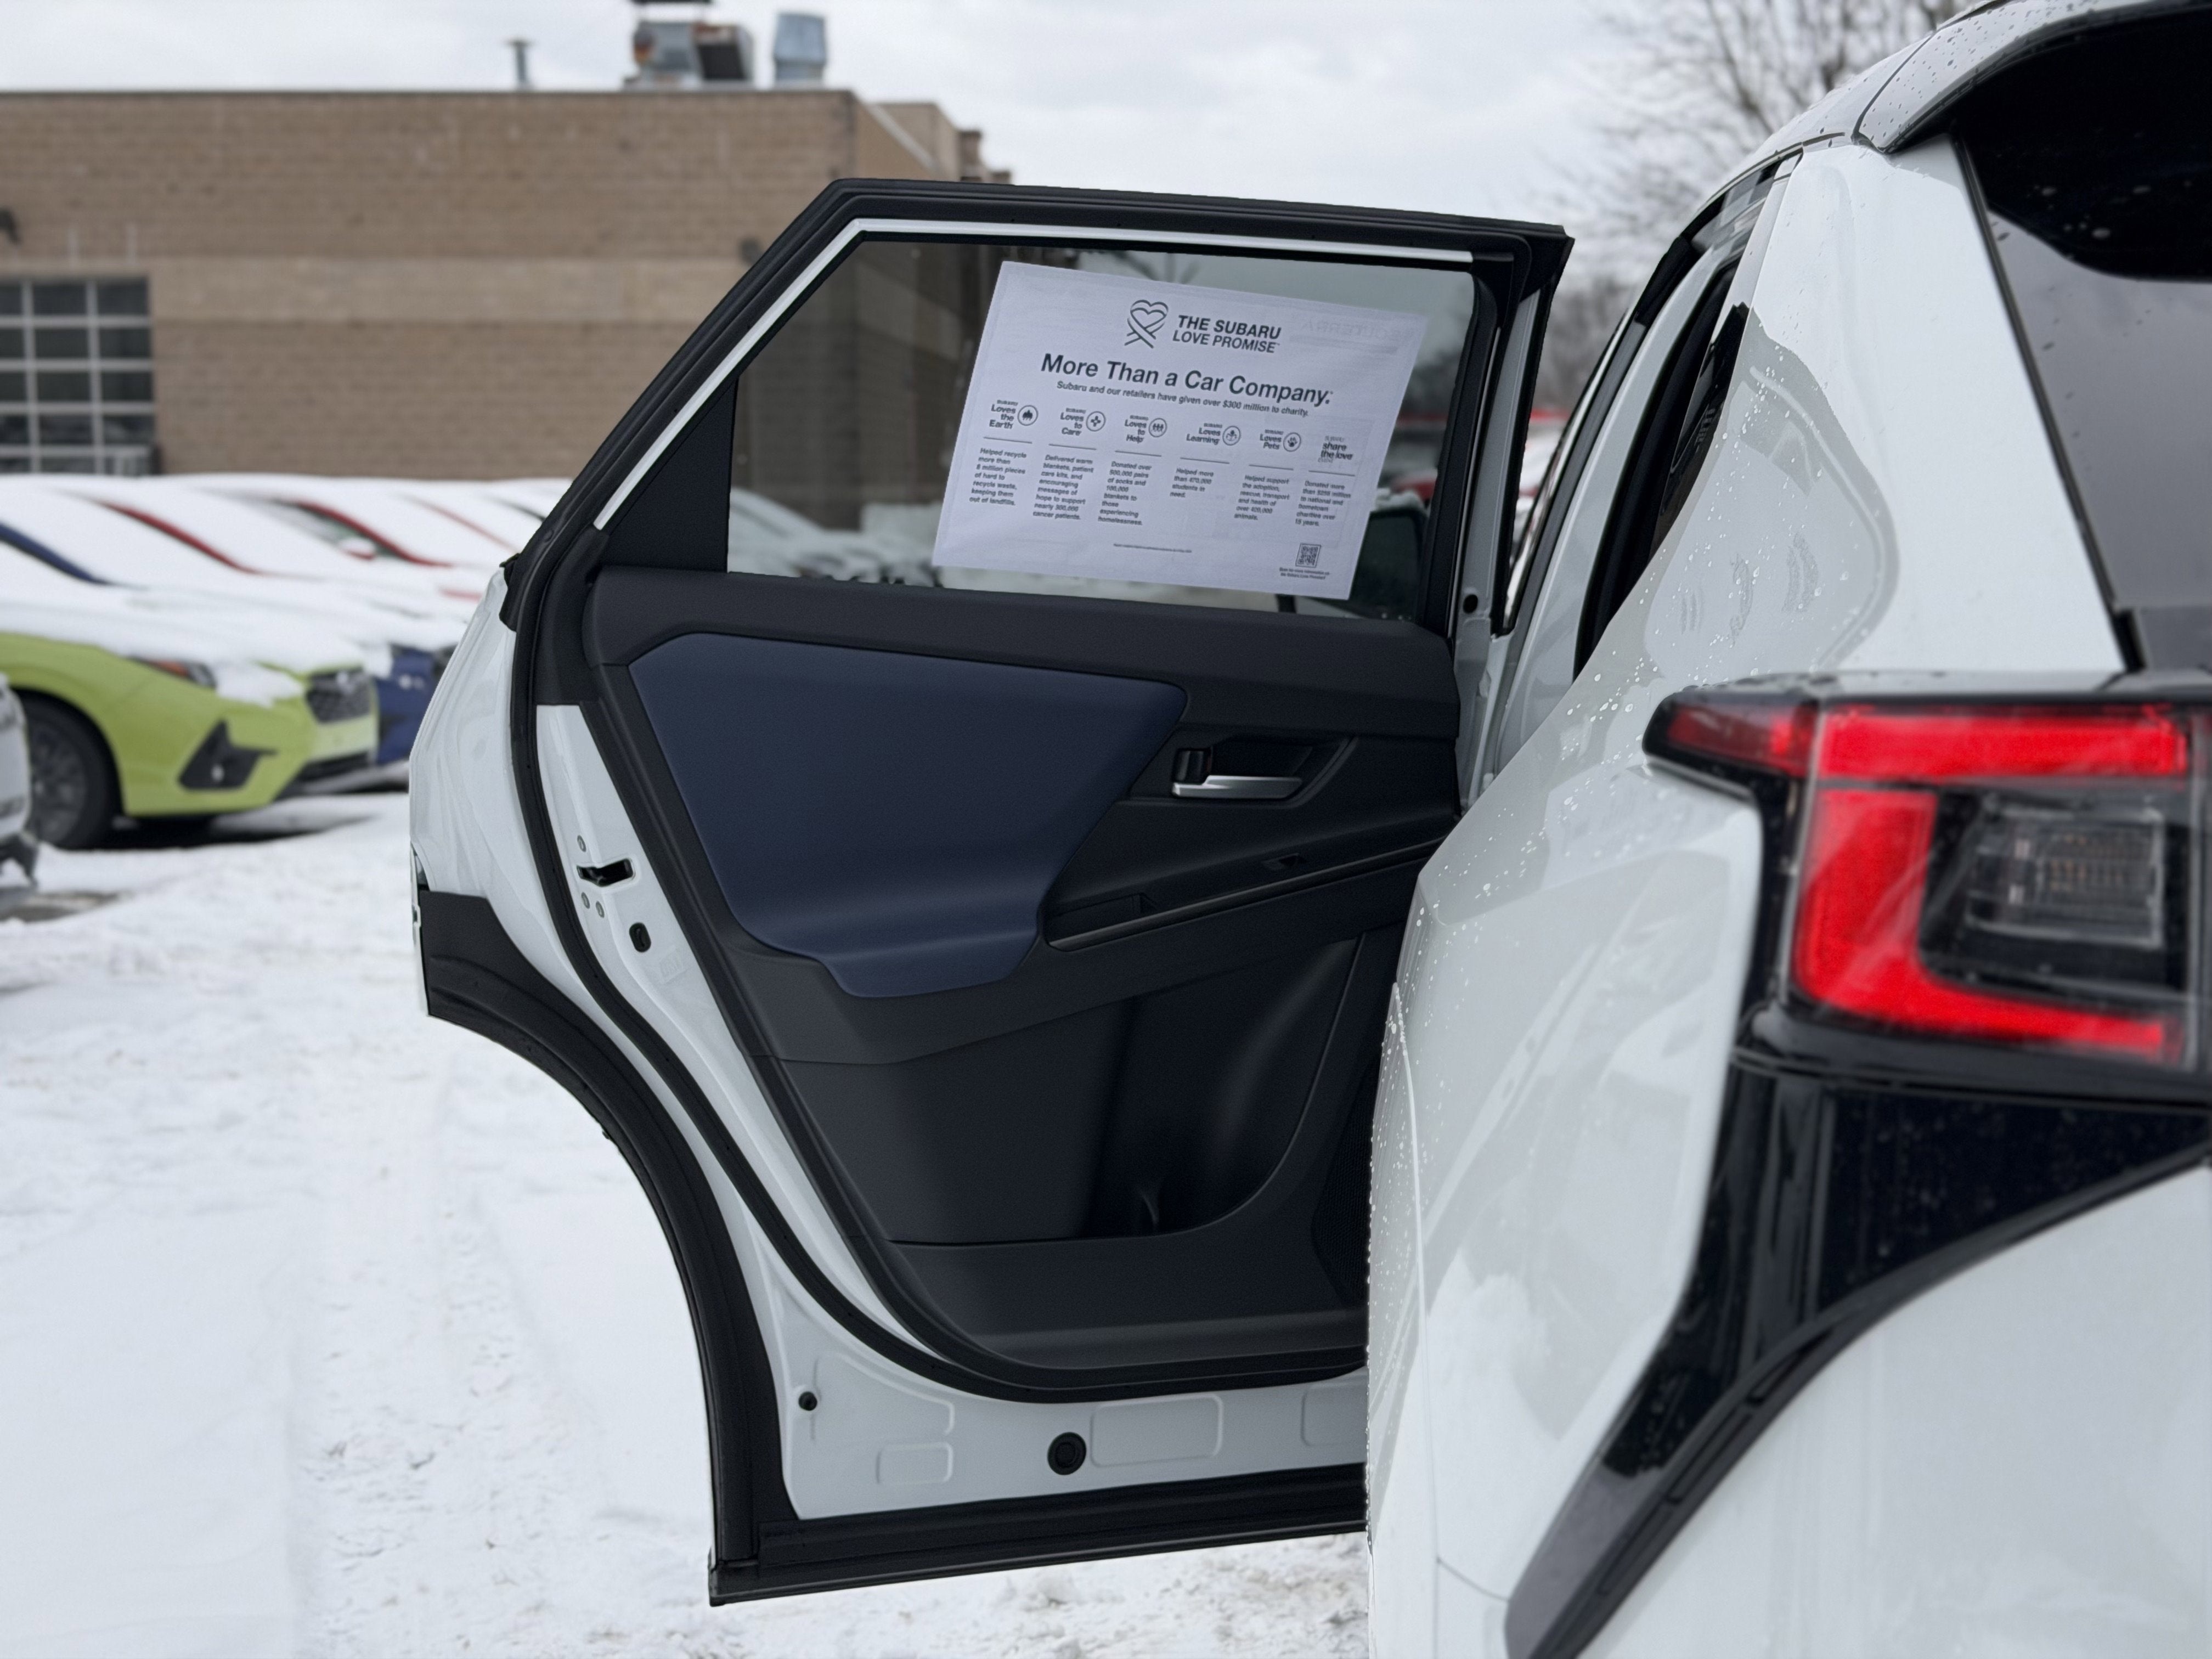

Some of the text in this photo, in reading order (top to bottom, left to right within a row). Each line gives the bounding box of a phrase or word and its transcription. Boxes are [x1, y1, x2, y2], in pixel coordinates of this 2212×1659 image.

[1178, 315, 1281, 339] THE SUBARU
[1172, 330, 1210, 345] LOVE
[1041, 353, 1098, 377] More
[1107, 360, 1159, 384] Than
[1165, 373, 1178, 386] a
[1185, 370, 1224, 391] Car
[1057, 381, 1087, 391] Subaru
[1122, 390, 1155, 399] retailers
[1158, 392, 1177, 402] have
[1178, 396, 1200, 404] given
[1222, 399, 1242, 409] $300
[1243, 403, 1269, 411] million
[991, 404, 1016, 414] Loves
[1060, 412, 1084, 421] Loves
[989, 419, 1013, 429] Earth
[1124, 419, 1147, 428] Loves
[1062, 427, 1081, 436] Care
[1199, 427, 1221, 436] Loves
[1126, 434, 1144, 443] Help
[1186, 433, 1220, 445] Learning
[1260, 433, 1282, 442] Loves
[1263, 441, 1280, 449] Pets
[1323, 442, 1347, 451] share
[1321, 450, 1353, 460] the love
